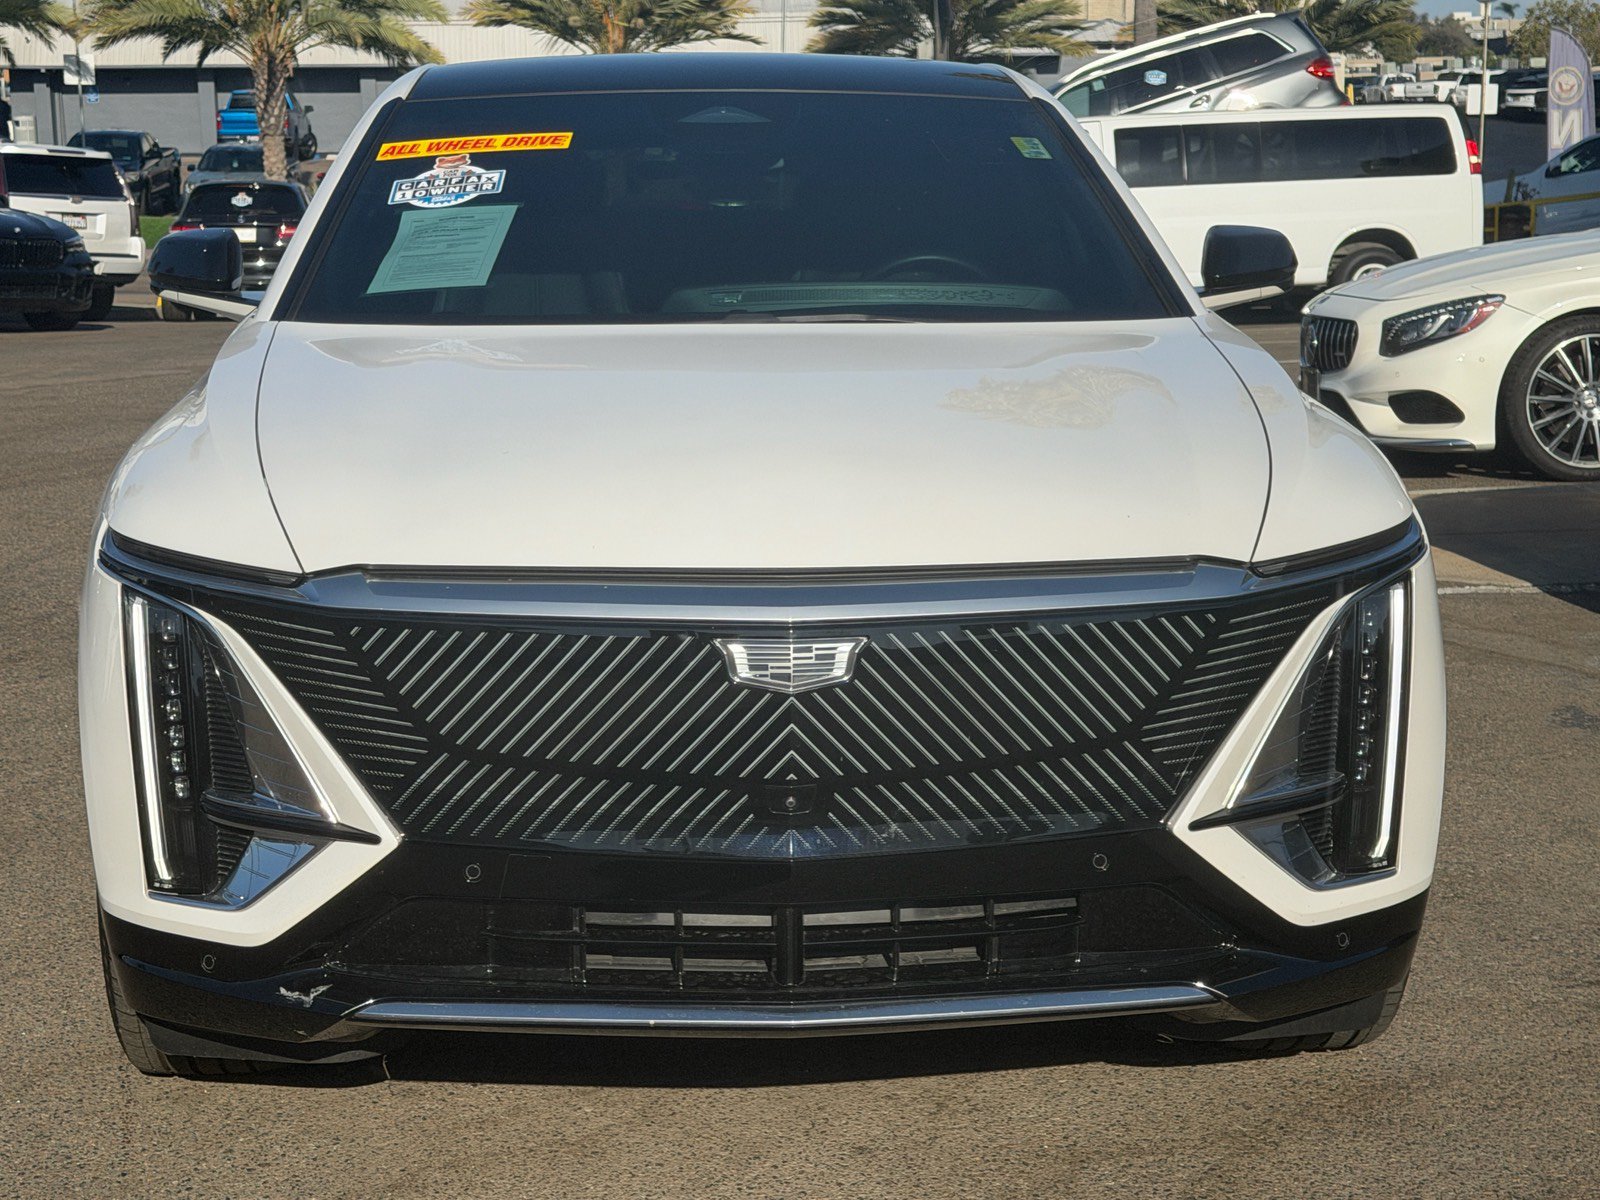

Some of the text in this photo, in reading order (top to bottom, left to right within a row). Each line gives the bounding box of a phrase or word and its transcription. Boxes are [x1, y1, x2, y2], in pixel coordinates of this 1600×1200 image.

[381, 135, 568, 157] ALL WHEEL DRIVE
[401, 176, 495, 190] CARFAX
[415, 183, 494, 197] OWNER
